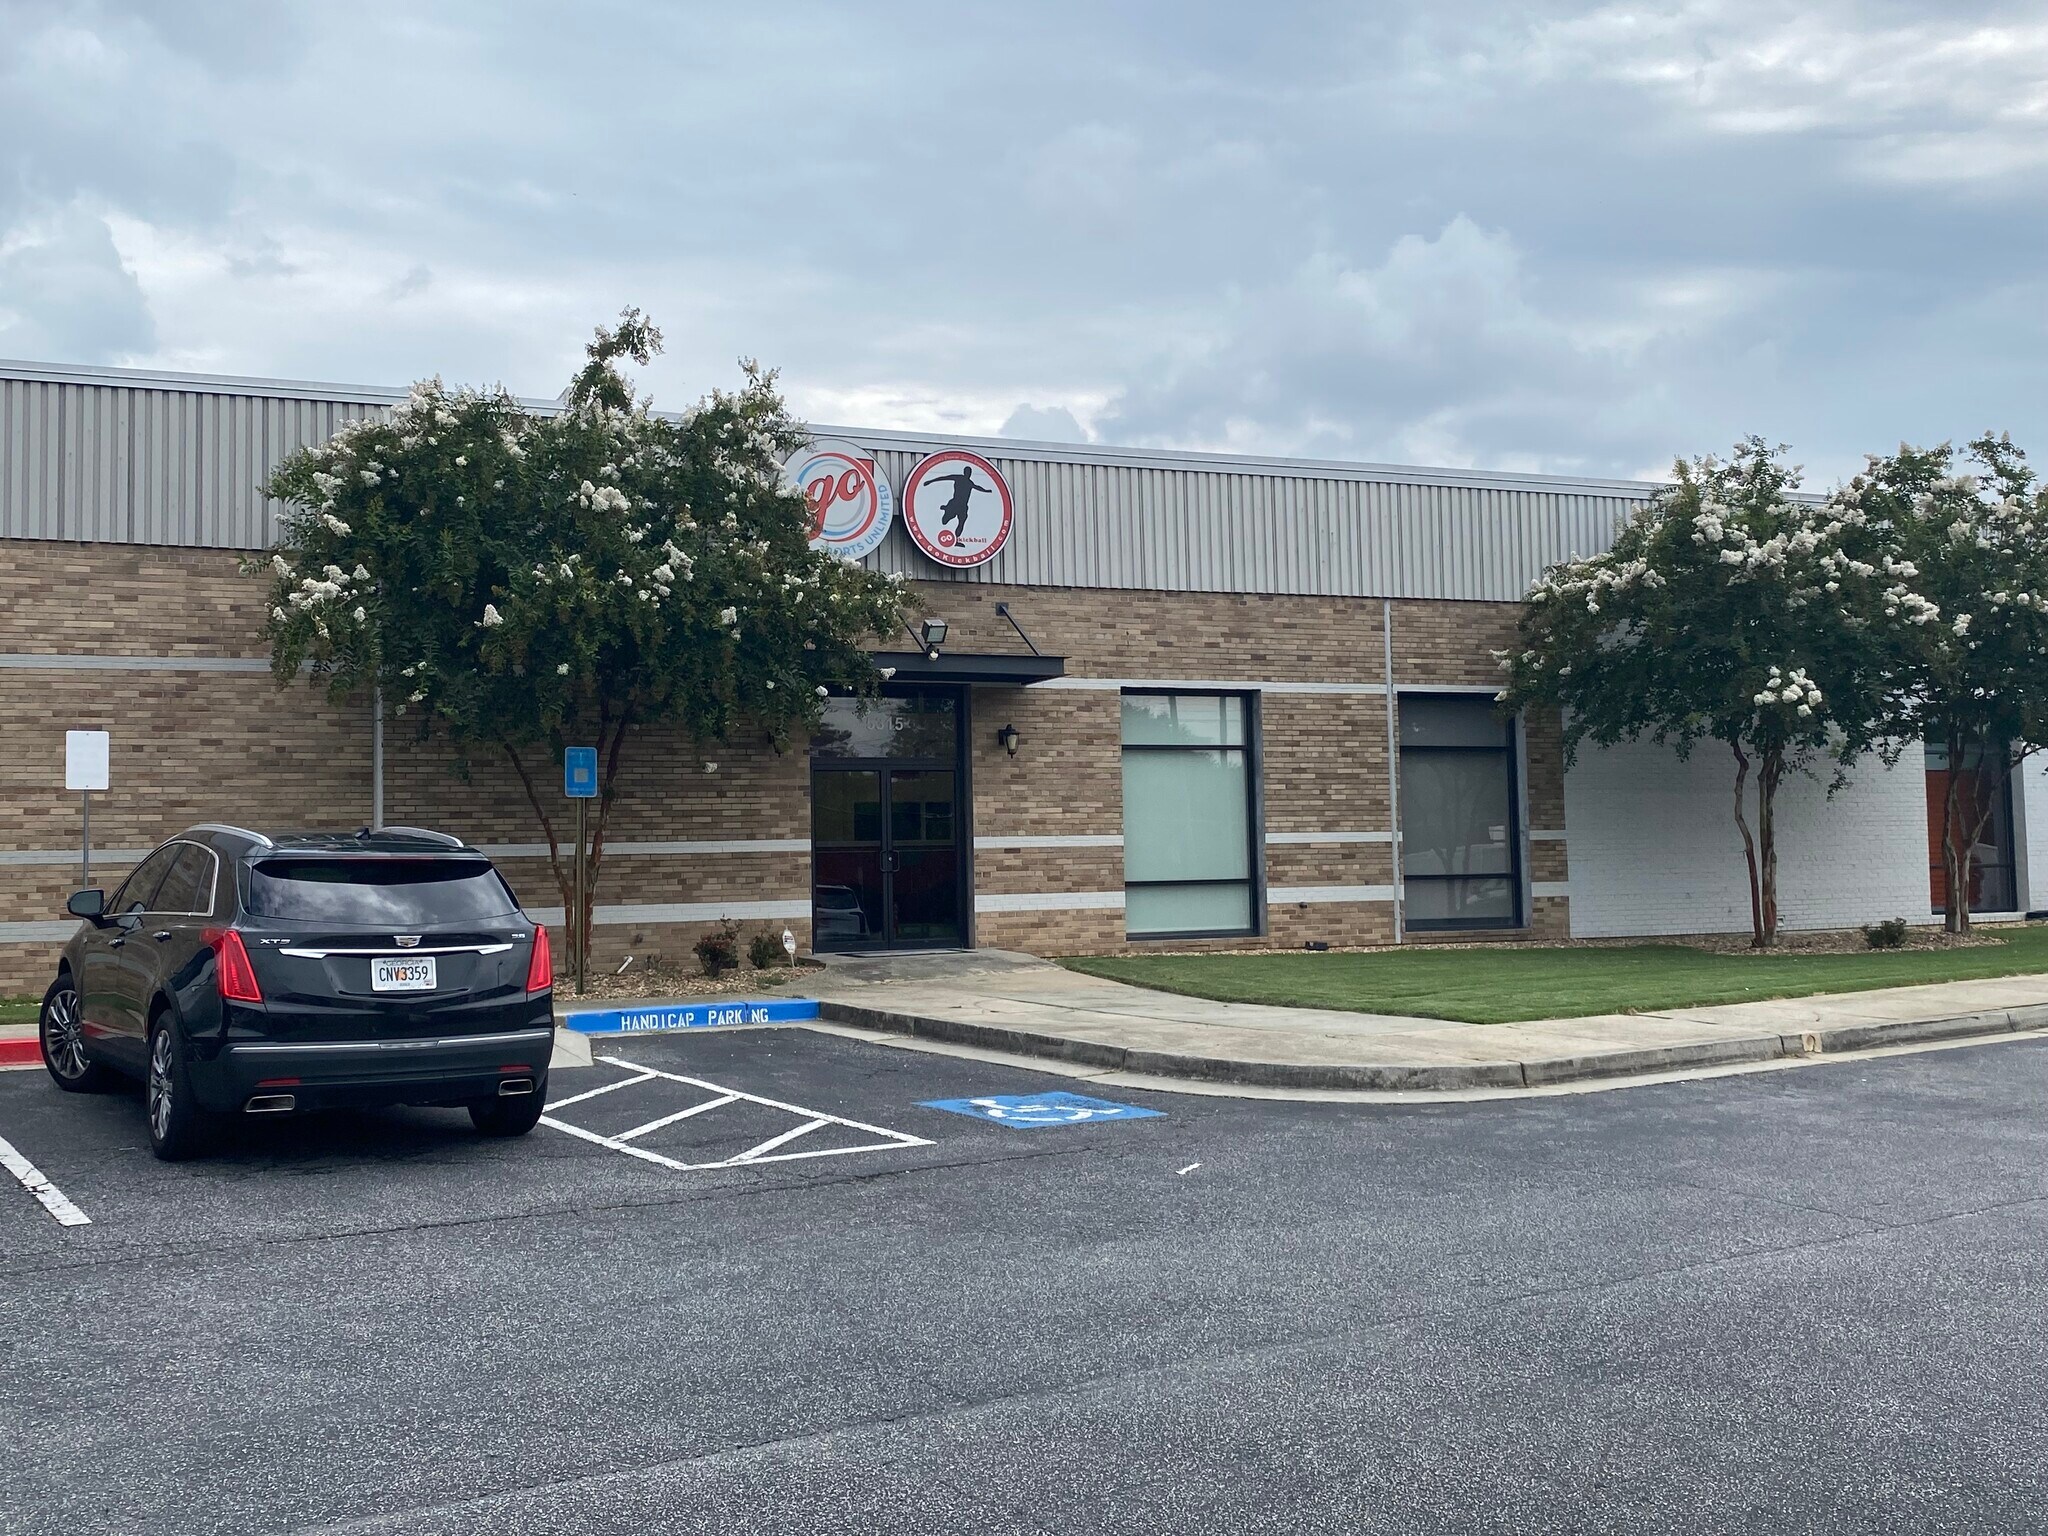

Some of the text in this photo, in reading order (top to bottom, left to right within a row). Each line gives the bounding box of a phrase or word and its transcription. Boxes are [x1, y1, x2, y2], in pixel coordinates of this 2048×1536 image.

[865, 484, 890, 545] UNLIMITED
[940, 534, 953, 542] GO
[379, 966, 428, 981] CNV3359
[620, 1012, 695, 1031] HANDICAP
